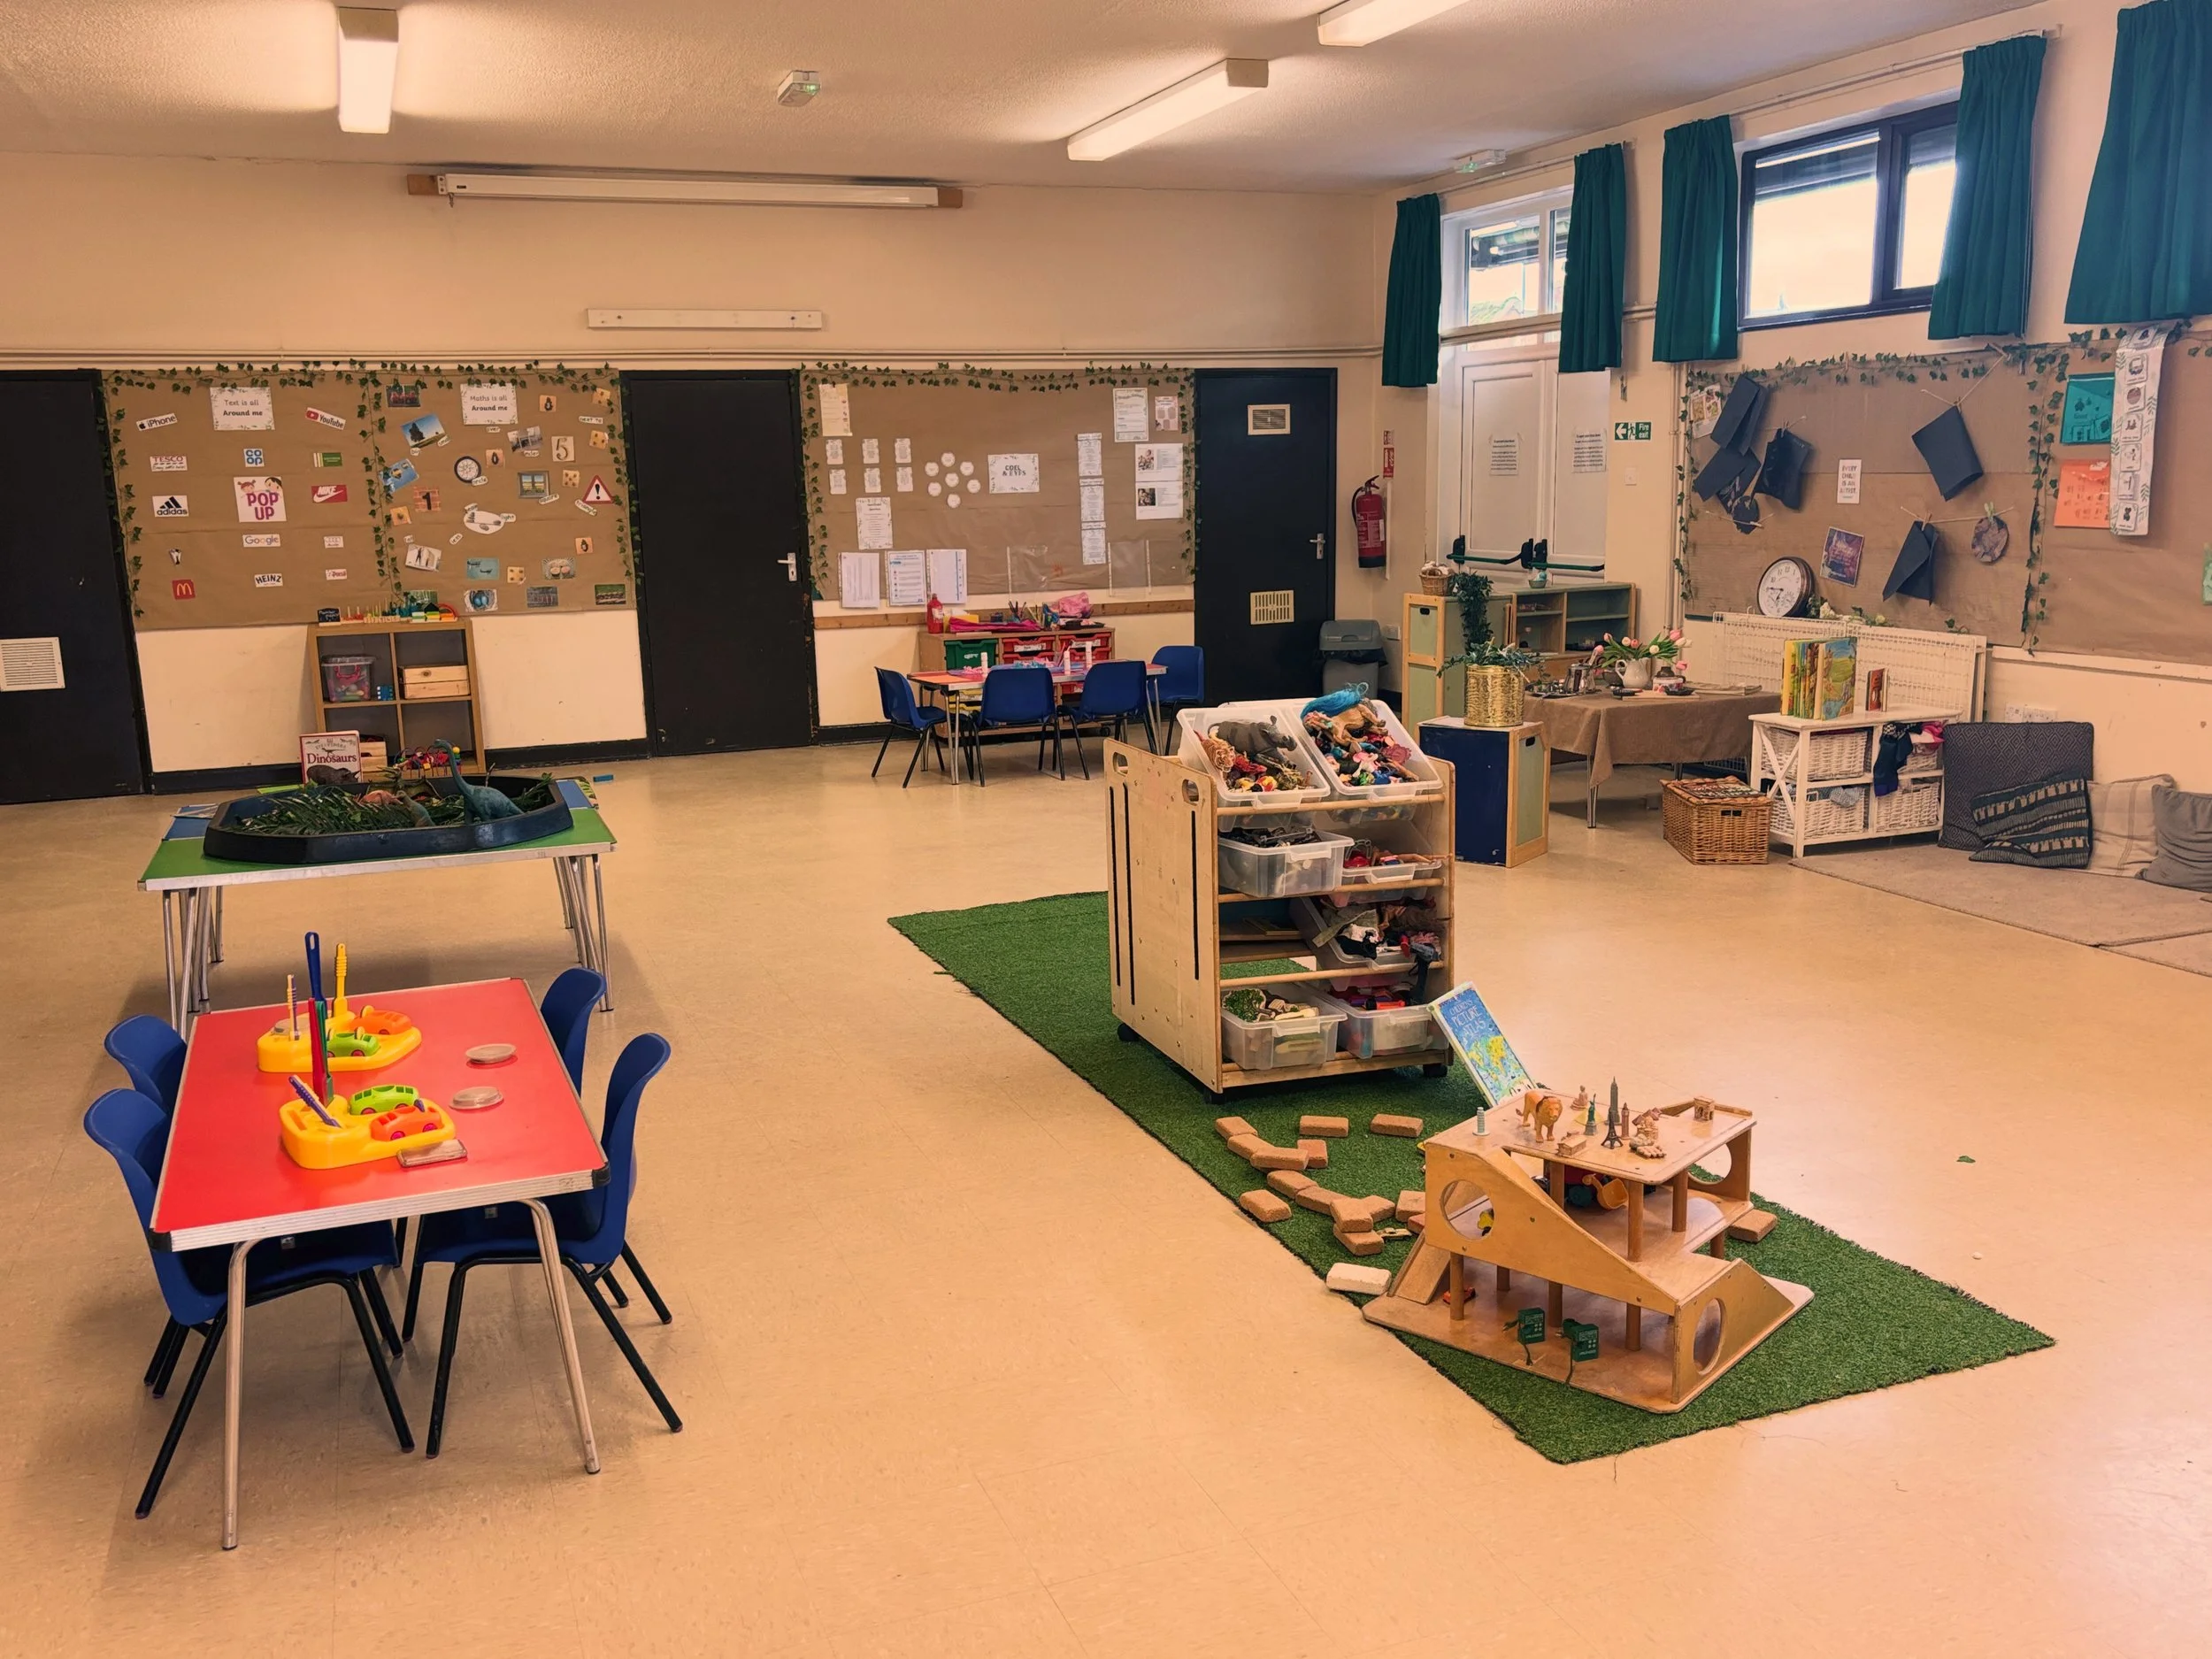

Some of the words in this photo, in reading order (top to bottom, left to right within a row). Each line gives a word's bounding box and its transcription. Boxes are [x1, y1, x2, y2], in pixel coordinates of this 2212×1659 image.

[147, 415, 176, 428] iPhone
[319, 413, 344, 428] YouTube
[556, 438, 568, 460] 5
[317, 486, 337, 495] NIKE
[246, 492, 280, 506] POP
[422, 491, 432, 511] 1
[254, 506, 275, 520] UP
[244, 535, 279, 546] Google
[255, 574, 282, 584] HEINZ
[307, 752, 357, 764] Dinosaurs
[1451, 1005, 1483, 1028] PICTURE
[1463, 1018, 1486, 1034] ATLAS
